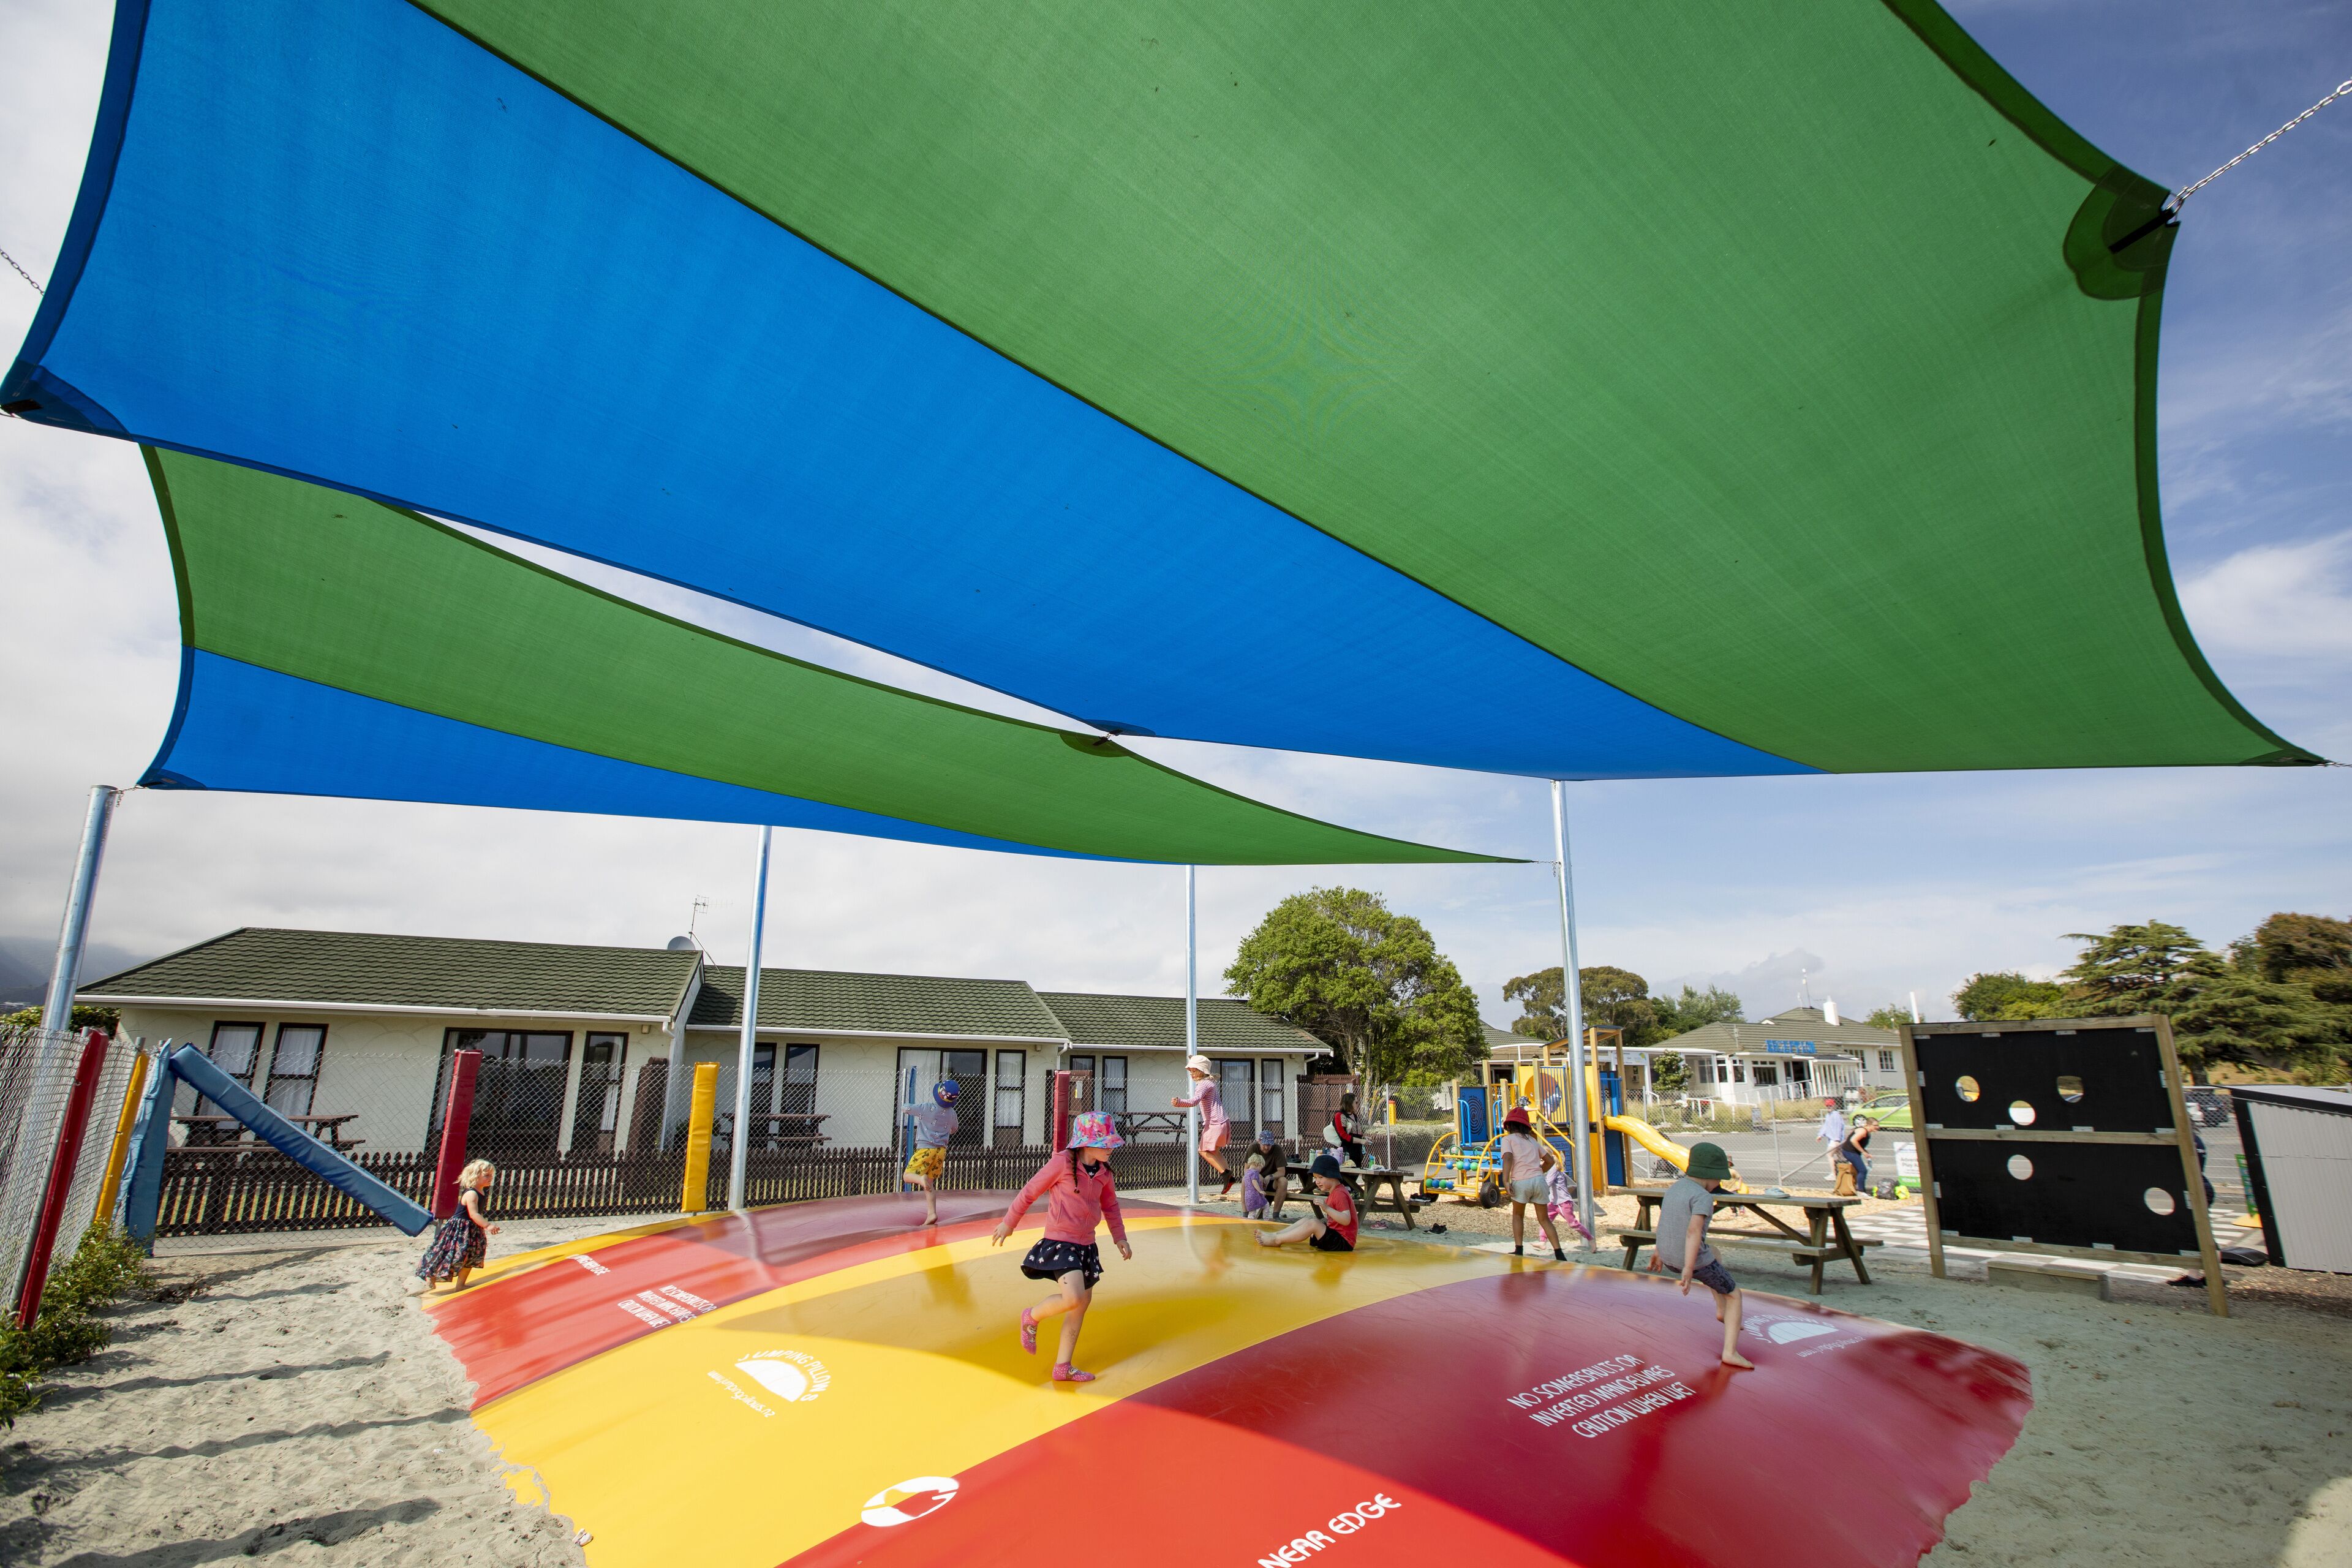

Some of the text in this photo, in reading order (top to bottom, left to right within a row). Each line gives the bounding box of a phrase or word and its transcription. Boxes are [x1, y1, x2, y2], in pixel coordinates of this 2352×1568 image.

[698, 1303, 717, 1314] OR
[1507, 1354, 1645, 1409] NO SOMERSAULTS OR
[1529, 1365, 1676, 1427] INVERTED MANOEUVRES
[1572, 1382, 1696, 1438] CAUTION WHEN WET
[1257, 1493, 1401, 1568] NEAR EDGE
